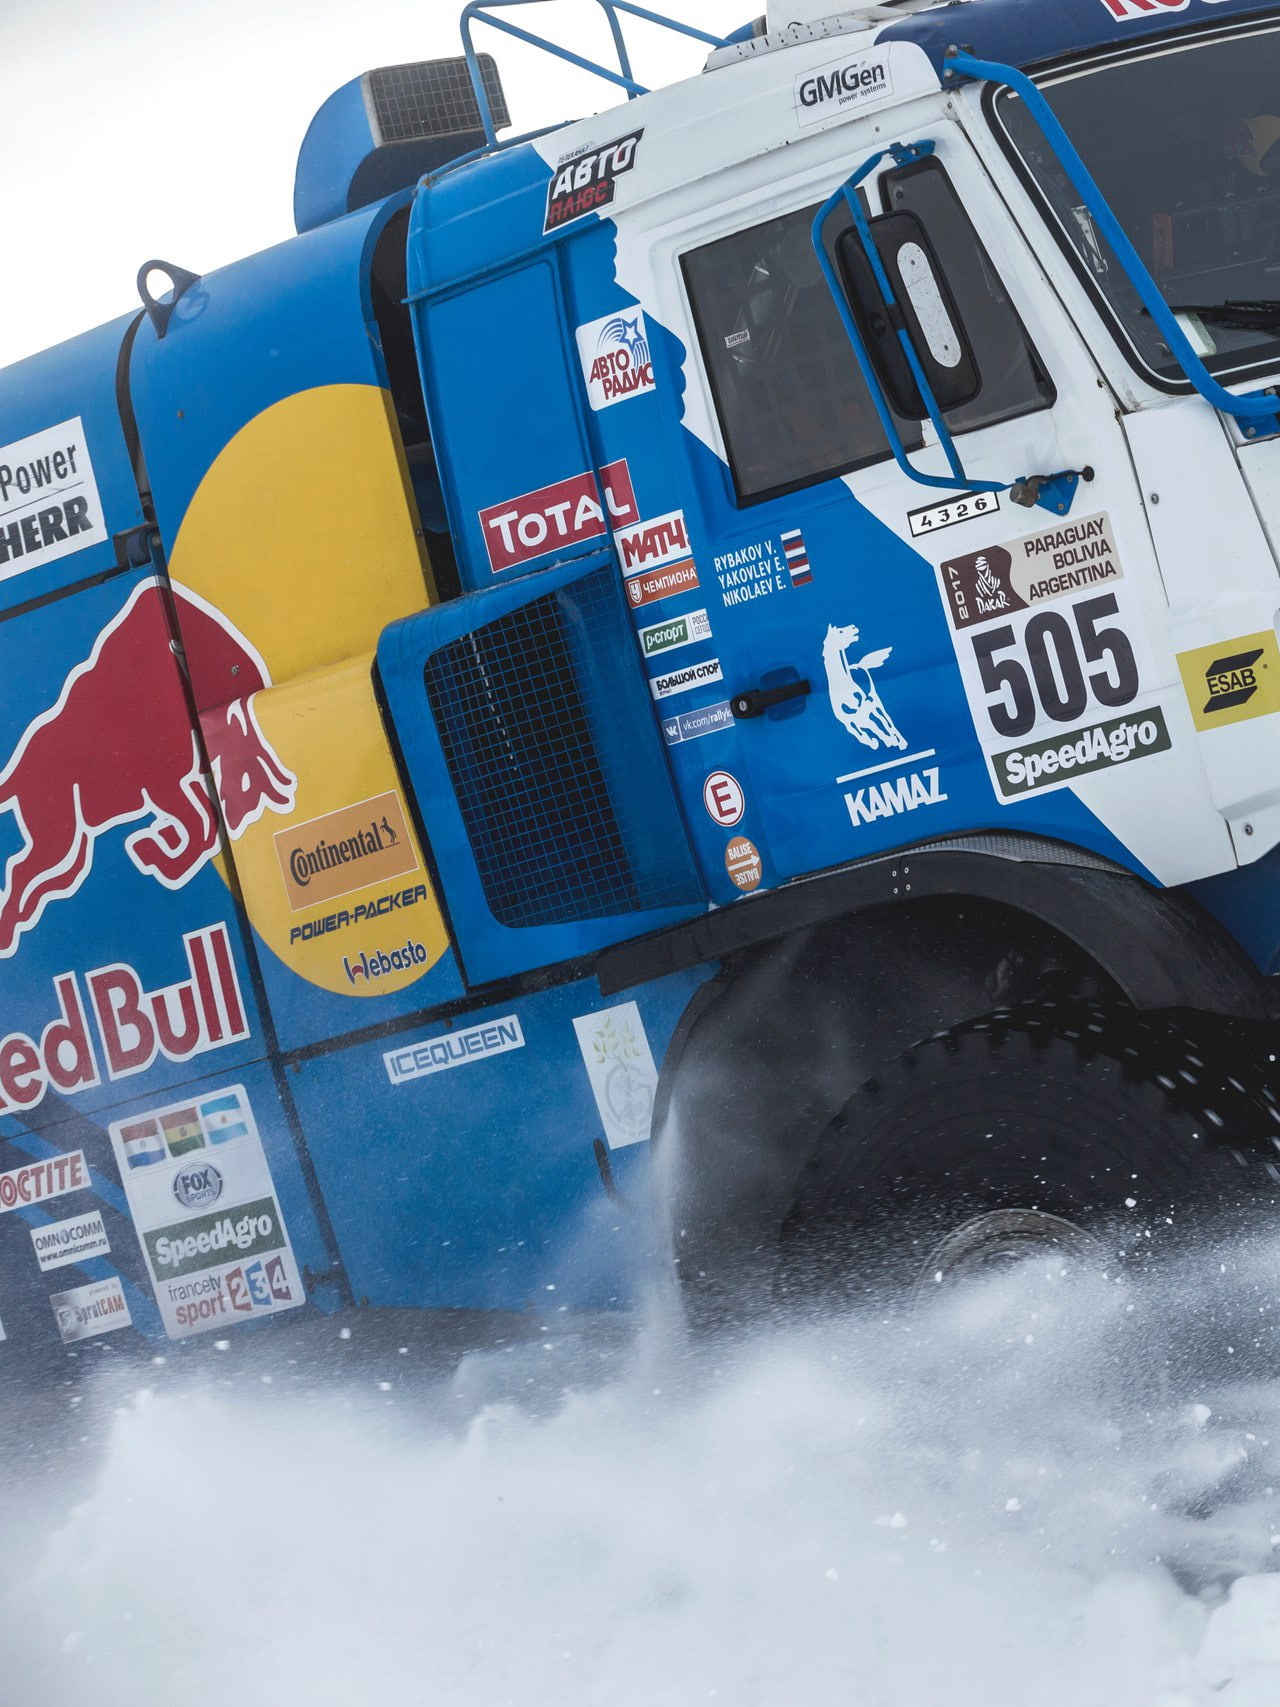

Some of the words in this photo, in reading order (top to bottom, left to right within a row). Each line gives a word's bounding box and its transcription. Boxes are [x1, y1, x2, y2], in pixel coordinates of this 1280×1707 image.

[800, 64, 885, 106] GMGen
[839, 93, 858, 105] power
[860, 82, 886, 97] systems
[552, 137, 637, 200] АВТО
[549, 181, 608, 224] ПЛЮС
[589, 348, 630, 384] АВТО
[602, 362, 655, 400] РАДИО
[0, 444, 77, 502] Power
[489, 486, 631, 553] TOTAL
[1024, 518, 1104, 557] PARAGUAY
[713, 543, 762, 572] RYBAKOV
[764, 540, 777, 555] V.
[718, 559, 771, 589] YAKOVLEV
[774, 557, 785, 571] E.
[1053, 539, 1112, 570] BOLIVIA
[643, 566, 697, 594] ЧЕМПИОНА
[722, 578, 773, 607] NIKOLAEV
[776, 575, 787, 590] E.
[948, 566, 969, 620] 2017
[1029, 560, 1117, 600] ARGENTINA
[692, 613, 710, 626] РОСС
[975, 591, 1010, 615] DAKAR
[656, 668, 697, 691] БОЛЬШОЙ
[696, 662, 720, 678] СПОР
[971, 592, 1139, 738] 505
[1207, 668, 1257, 695] ESAB
[1005, 720, 1158, 786] SpeedAgro
[710, 781, 738, 818] E
[844, 766, 948, 827] KAMAZ
[290, 822, 385, 886] Continental
[728, 841, 752, 860] BALISE
[735, 867, 760, 886] BALISE
[290, 884, 427, 945] POWER-PACKER
[343, 938, 427, 986] Webasto
[0, 975, 97, 1110] ed
[89, 927, 246, 1074] Bull
[389, 1021, 518, 1077] ICEQUEEN
[0, 1154, 82, 1208] OCTITE
[181, 1168, 214, 1195] FOX
[186, 1189, 217, 1203] SPORTS
[35, 1220, 103, 1250] OMNICOMM
[40, 1238, 106, 1263] www.omnicomm.ru
[155, 1214, 273, 1268] SpeedAgro
[168, 1274, 222, 1303] francetv
[75, 1294, 125, 1325] SprutCAM
[176, 1290, 226, 1327] sport
